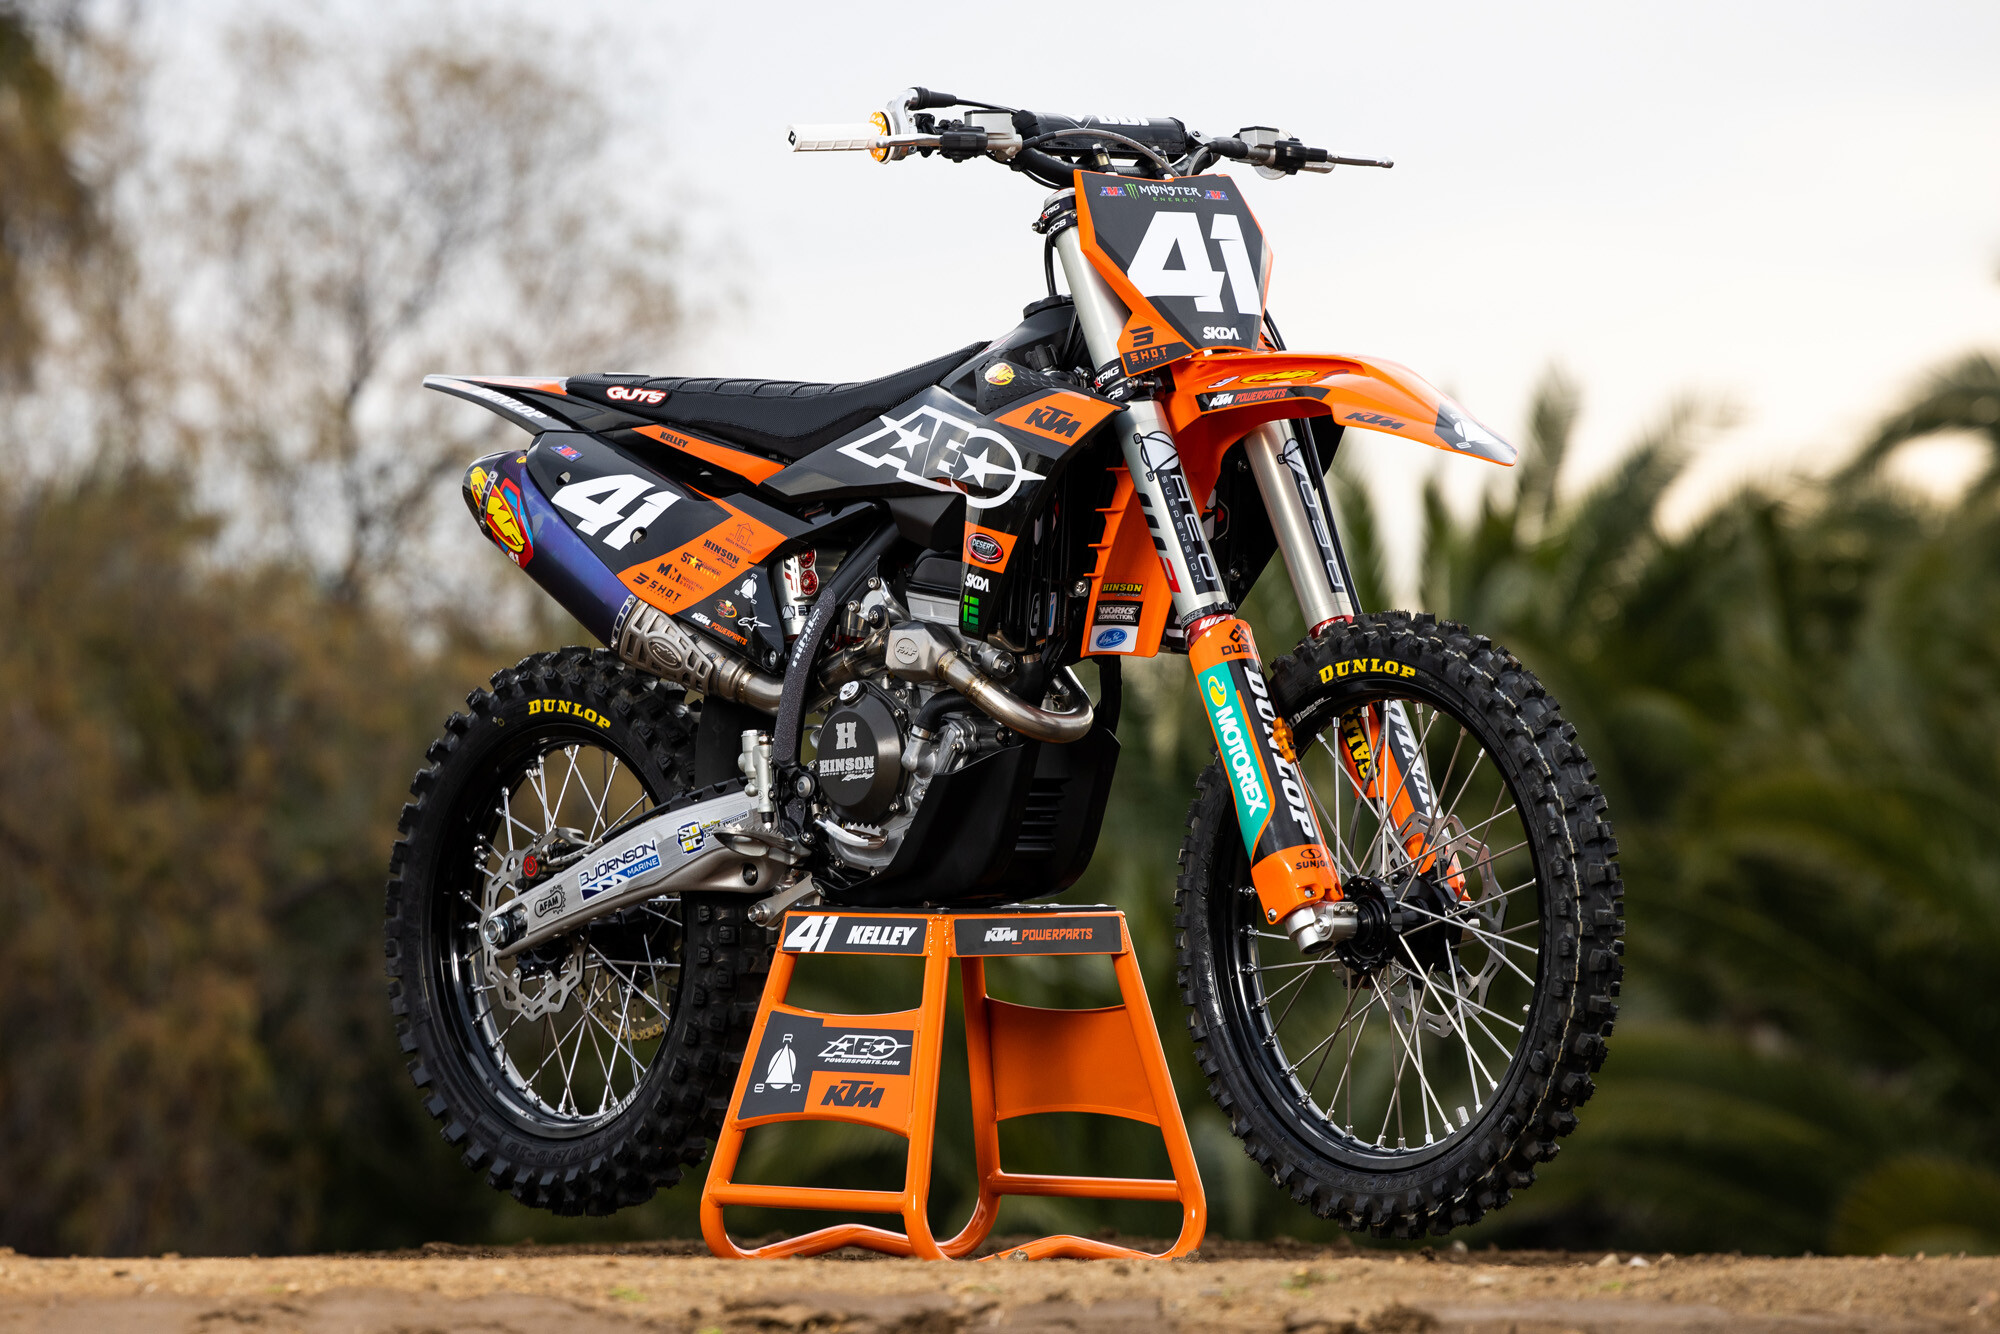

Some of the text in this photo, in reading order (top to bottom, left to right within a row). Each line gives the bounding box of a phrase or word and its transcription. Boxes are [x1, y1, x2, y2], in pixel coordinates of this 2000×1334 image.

[1127, 211, 1263, 316] 41
[1201, 326, 1240, 340] SKDA
[1129, 346, 1168, 363] SHOT
[478, 387, 549, 419] DUNLOP
[606, 386, 667, 403] GUTS
[1209, 388, 1288, 407] KTM POWERPARTS
[1024, 405, 1082, 438] KTM
[1344, 412, 1406, 430] KTM
[659, 431, 689, 448] KELLEY
[550, 473, 682, 551] 41
[1161, 475, 1202, 583] SUSPENSION
[703, 538, 740, 564] HINSON
[971, 538, 995, 552] DESERT
[649, 580, 682, 601] SHOT
[964, 573, 990, 593] SKDA
[1102, 583, 1143, 593] HINSON
[1099, 606, 1137, 615] WORKS
[691, 612, 748, 646] KTM POWERPARTS
[1319, 658, 1416, 684] DUNLOP
[528, 699, 611, 729] DUNLOP
[836, 721, 857, 750] H
[819, 756, 875, 773] HINSON
[1215, 705, 1267, 818] MOTOREX
[579, 839, 657, 887] BJÖRNSON
[626, 856, 660, 877] MARINE
[540, 895, 559, 912] AFAM
[783, 916, 918, 952] 41 KELLEY
[983, 927, 1094, 942] KTM POWERPARTS
[824, 1057, 901, 1066] POWERSPORTS.COM
[820, 1079, 885, 1108] KTM
